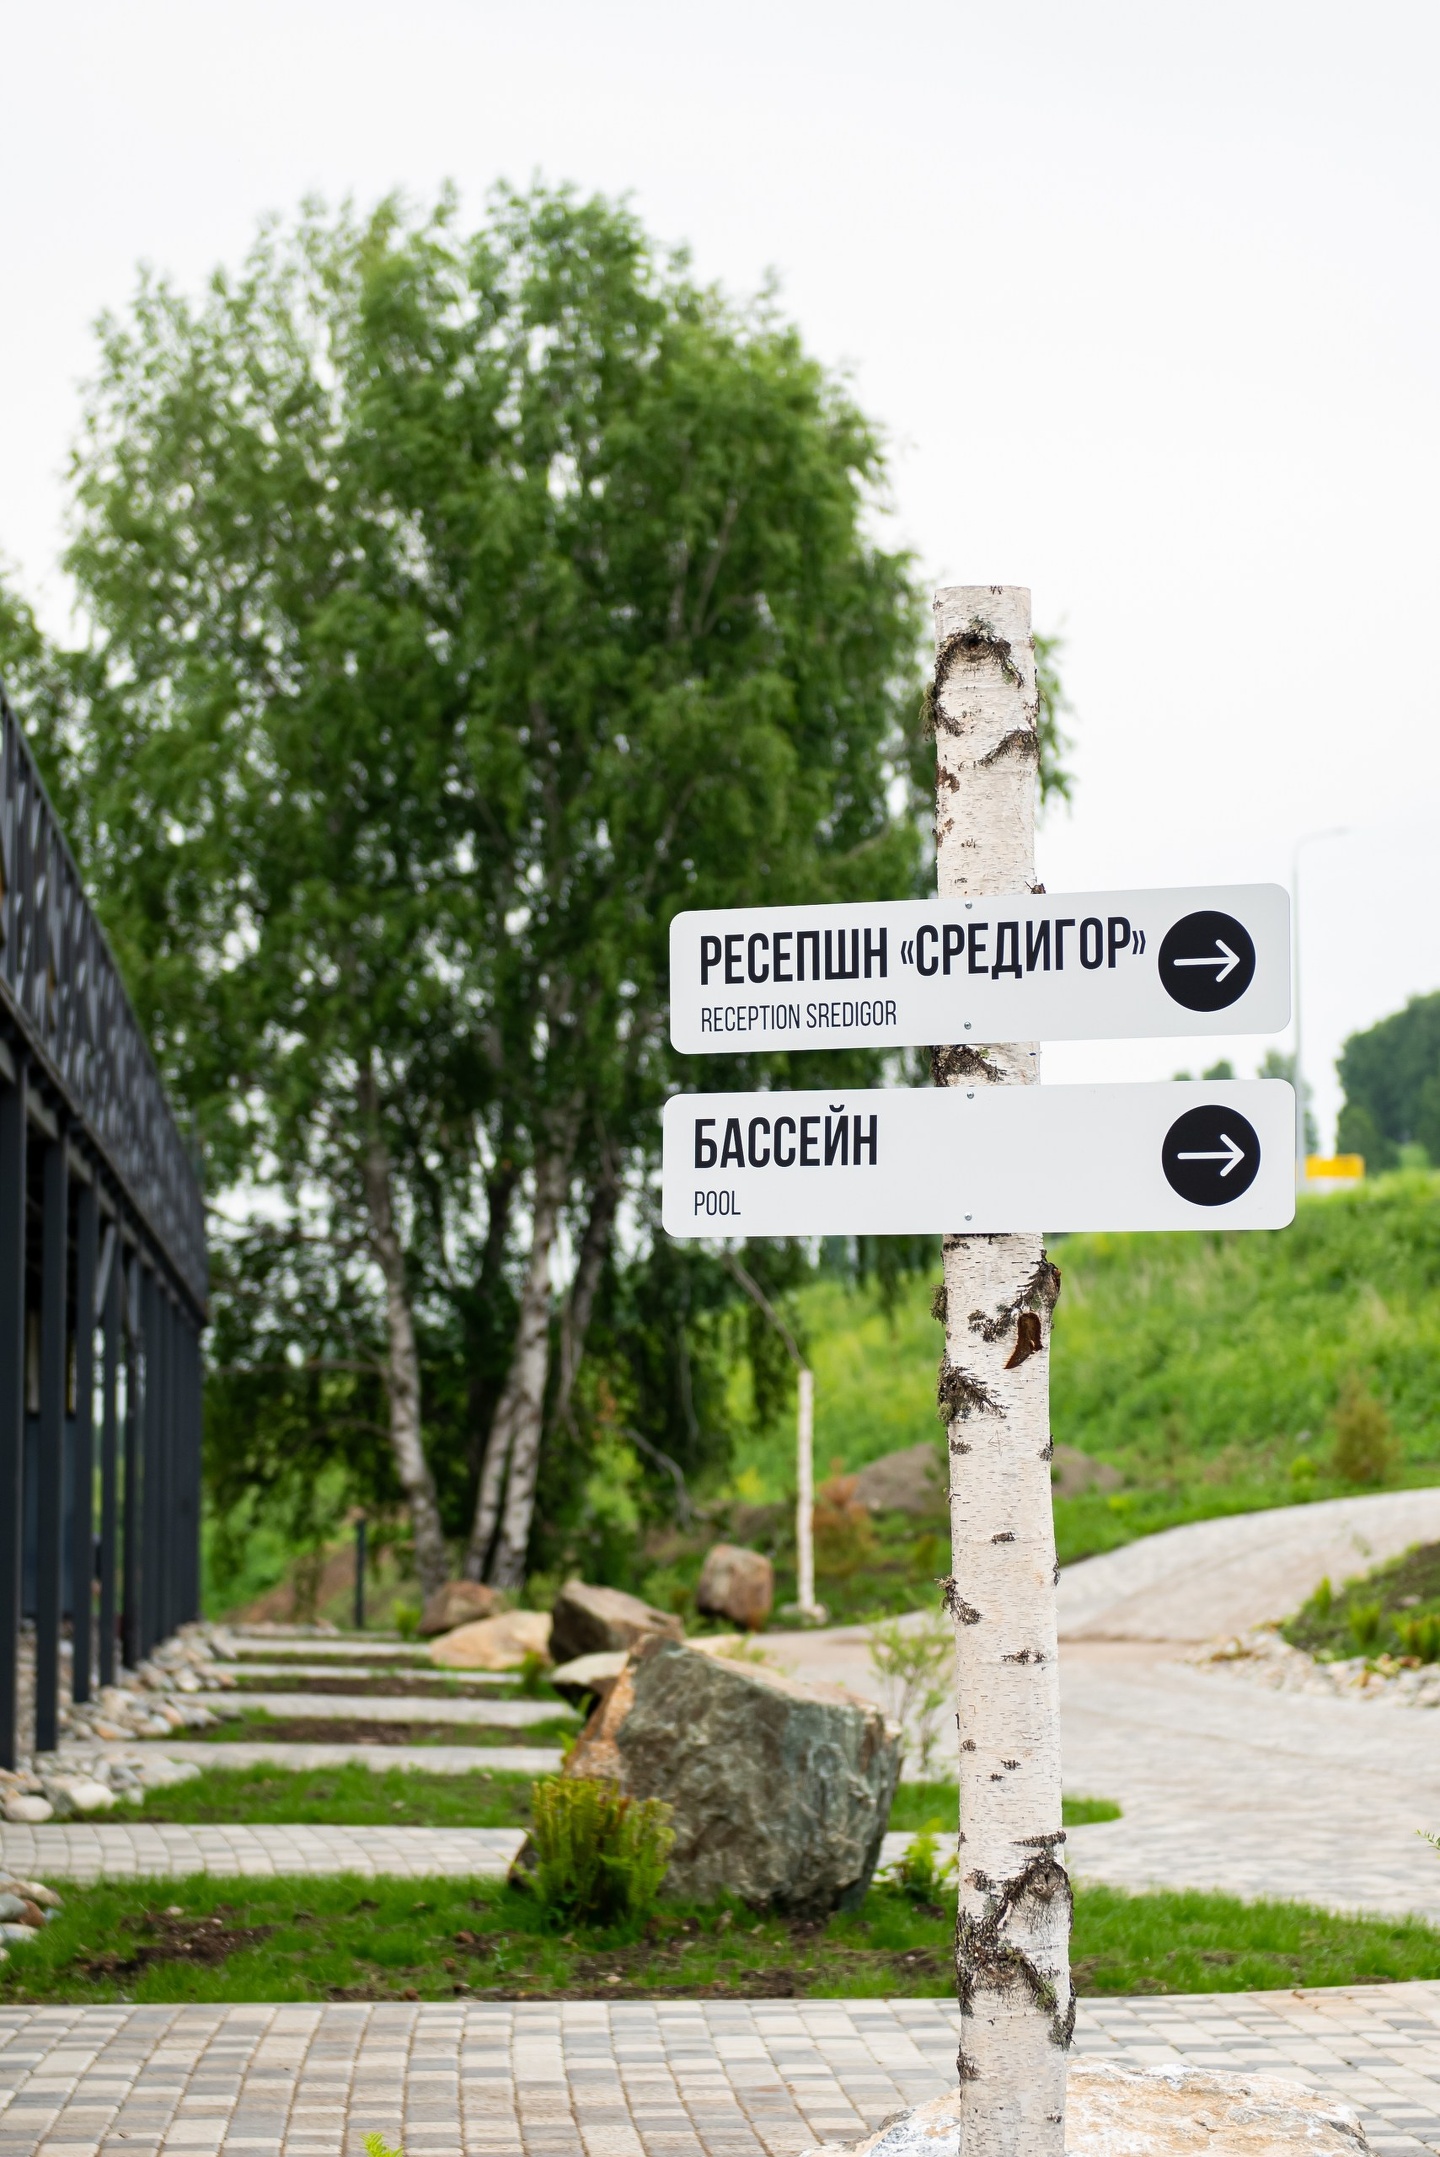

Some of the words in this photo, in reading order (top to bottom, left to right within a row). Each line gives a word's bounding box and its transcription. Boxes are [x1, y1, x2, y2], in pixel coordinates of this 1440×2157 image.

[700, 927, 888, 986] РЕСЕПШН
[900, 916, 1147, 981] «СРЕДИГОР»
[701, 1003, 800, 1033] RECEPTION
[806, 1000, 897, 1029] SREDIGOR
[694, 1104, 878, 1169] БАССЕЙН
[694, 1190, 742, 1216] POOL
